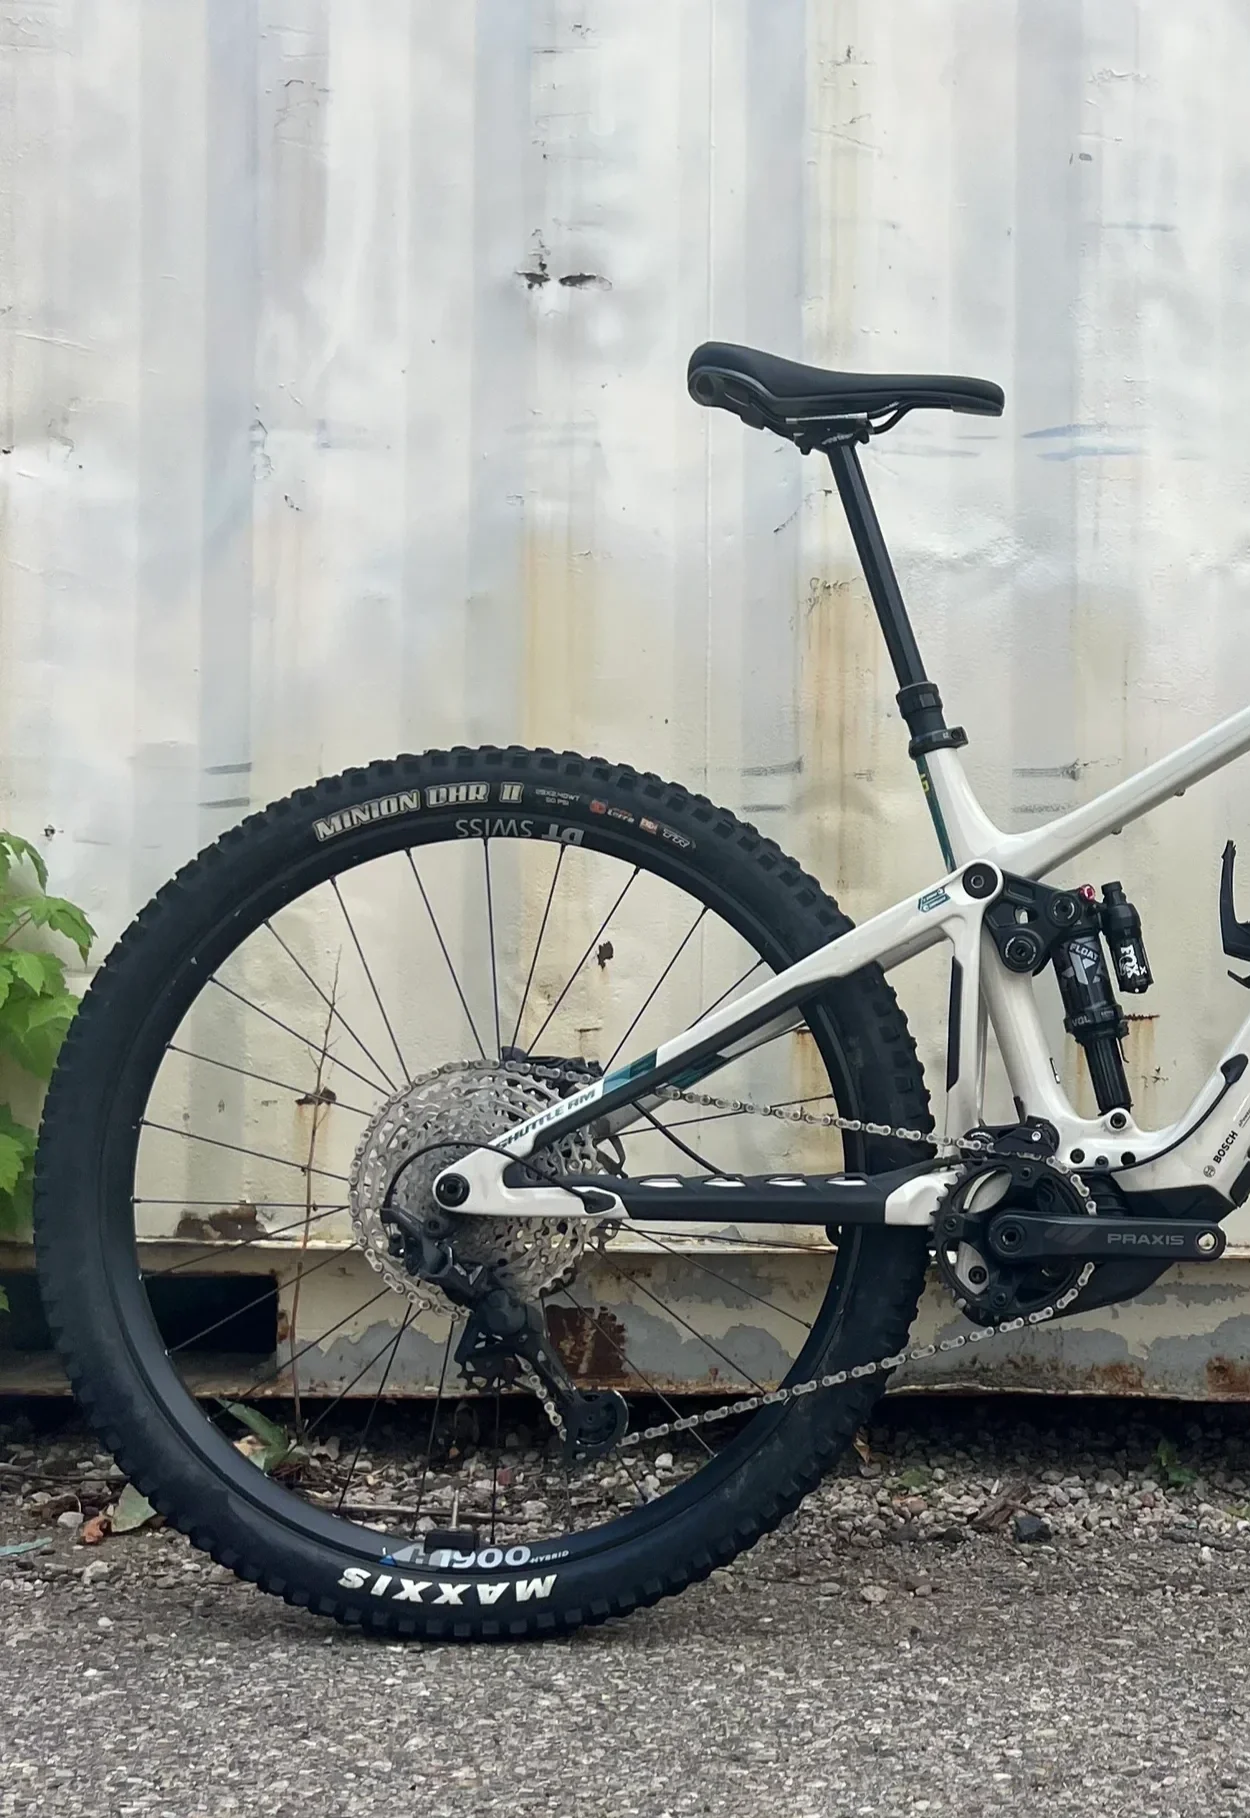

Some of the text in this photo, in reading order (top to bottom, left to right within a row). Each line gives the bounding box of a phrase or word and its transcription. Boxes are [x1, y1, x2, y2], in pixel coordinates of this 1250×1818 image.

[311, 781, 525, 843] MINION DHR II
[455, 818, 585, 846] DT SWISS
[1069, 943, 1099, 961] FLOAT
[1118, 944, 1142, 979] FOX
[495, 1106, 565, 1149] SHUTTLE
[1212, 1130, 1239, 1164] BOSCH
[1107, 1233, 1185, 1246] PRAXIS
[530, 1550, 570, 1564] HYBRID
[337, 1566, 559, 1606] MAXXIS
